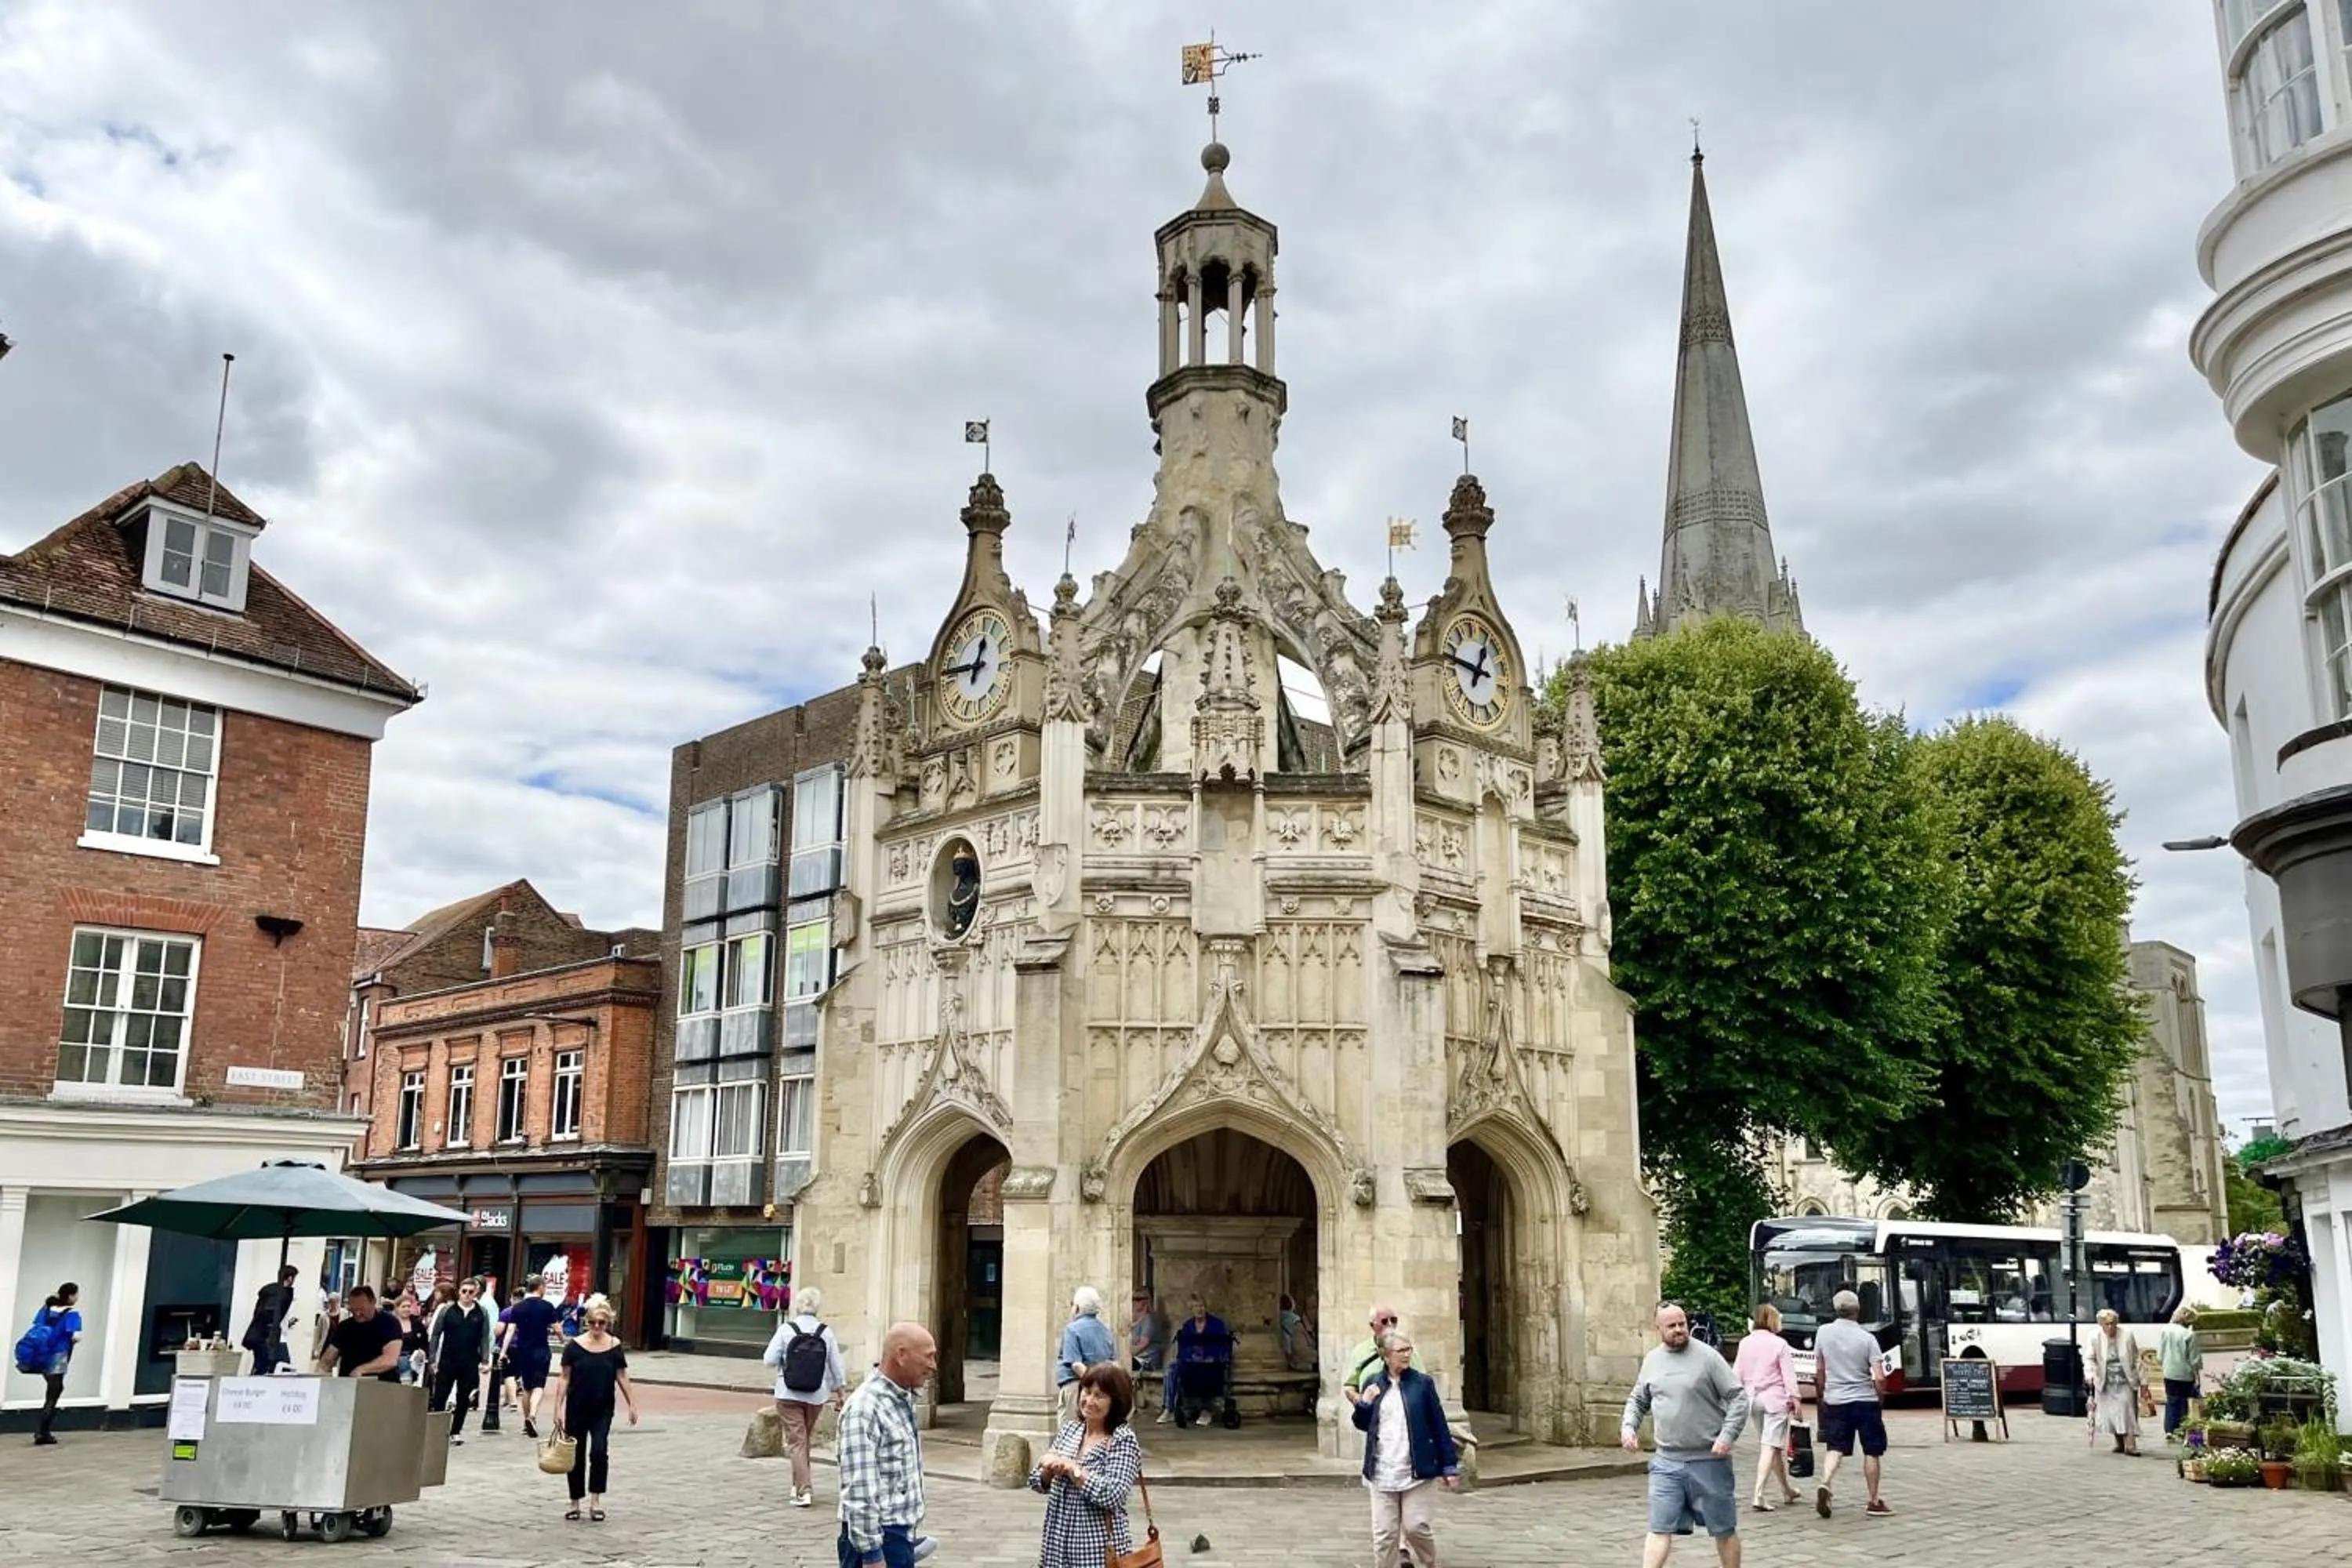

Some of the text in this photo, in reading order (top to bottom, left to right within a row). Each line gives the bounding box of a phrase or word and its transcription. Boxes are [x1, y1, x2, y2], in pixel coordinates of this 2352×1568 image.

[230, 1071, 299, 1084] EAST STREET
[481, 1210, 507, 1227] Blacks
[415, 1268, 434, 1280] SALE
[543, 1271, 565, 1285] SALE
